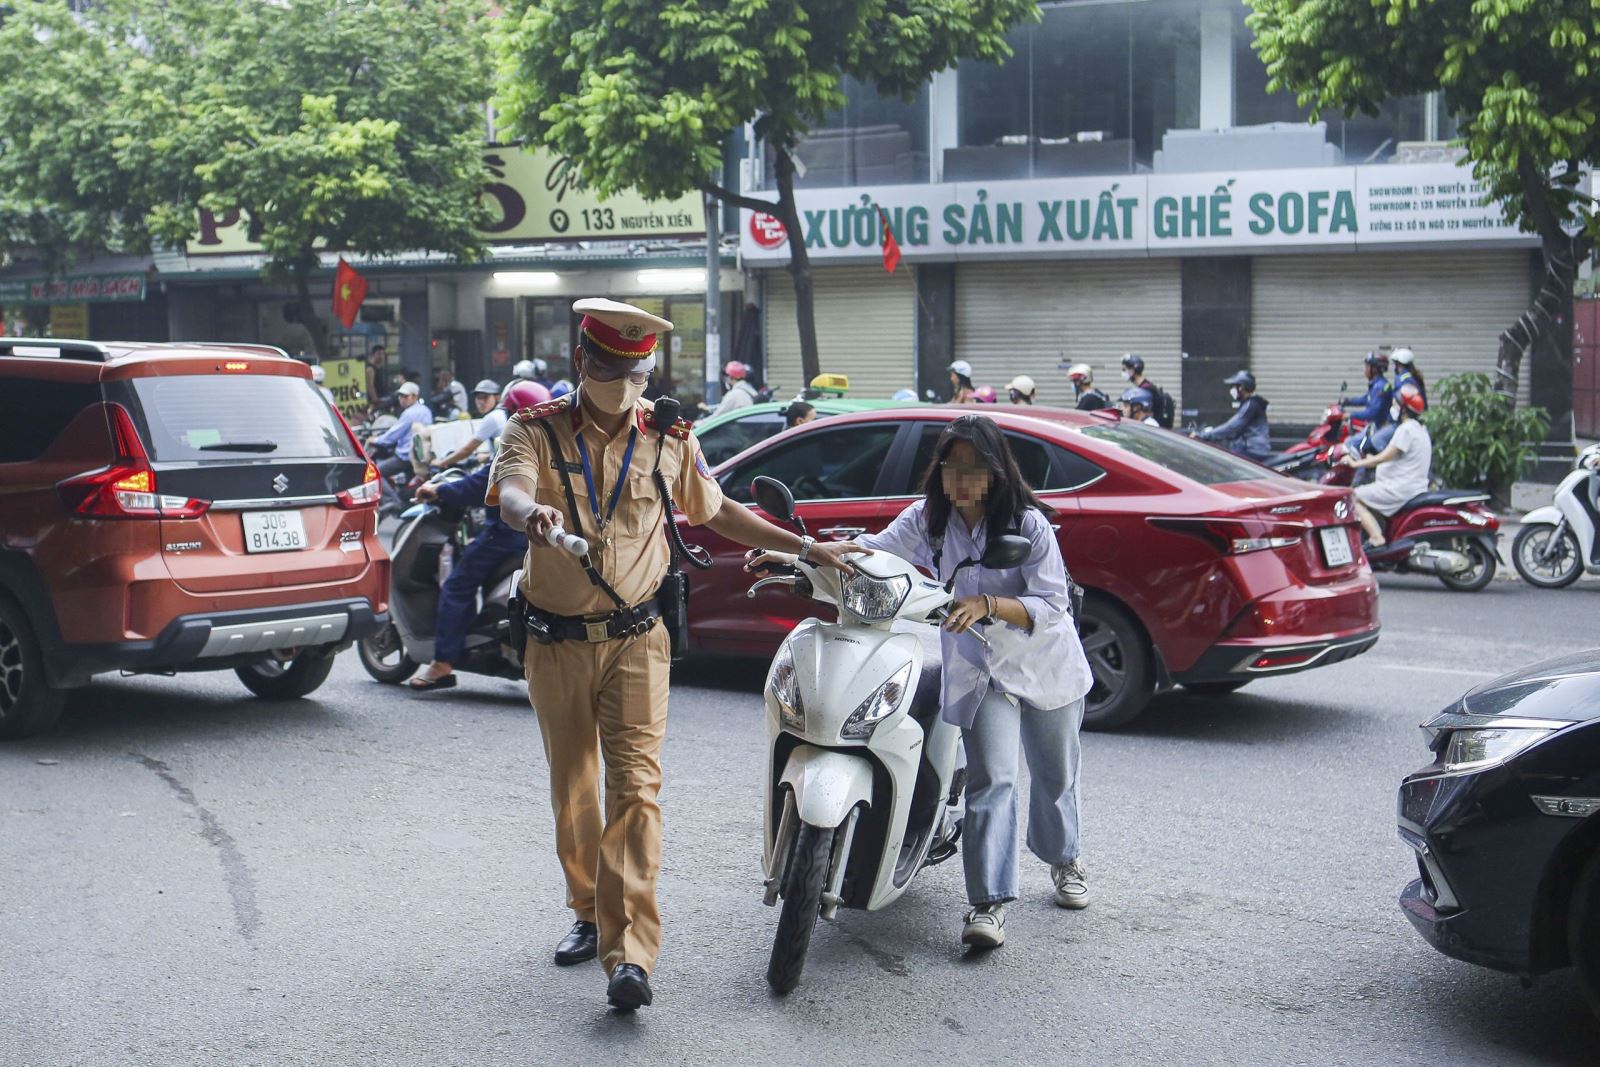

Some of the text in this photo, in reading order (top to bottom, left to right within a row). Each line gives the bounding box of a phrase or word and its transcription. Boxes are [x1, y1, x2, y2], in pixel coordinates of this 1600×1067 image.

[1369, 186, 1413, 197] SHOWROOM
[803, 194, 929, 249] XƯỞNG
[942, 189, 1023, 247] SẢN
[1038, 183, 1139, 243] XUẤT
[1154, 179, 1237, 239] GHẾ
[1248, 190, 1359, 236] SOFA
[1369, 200, 1411, 212] SHOWROOM
[581, 208, 615, 231] 133
[262, 514, 287, 531] 30G
[253, 532, 300, 549] 814.38
[834, 637, 861, 645] HONDA
